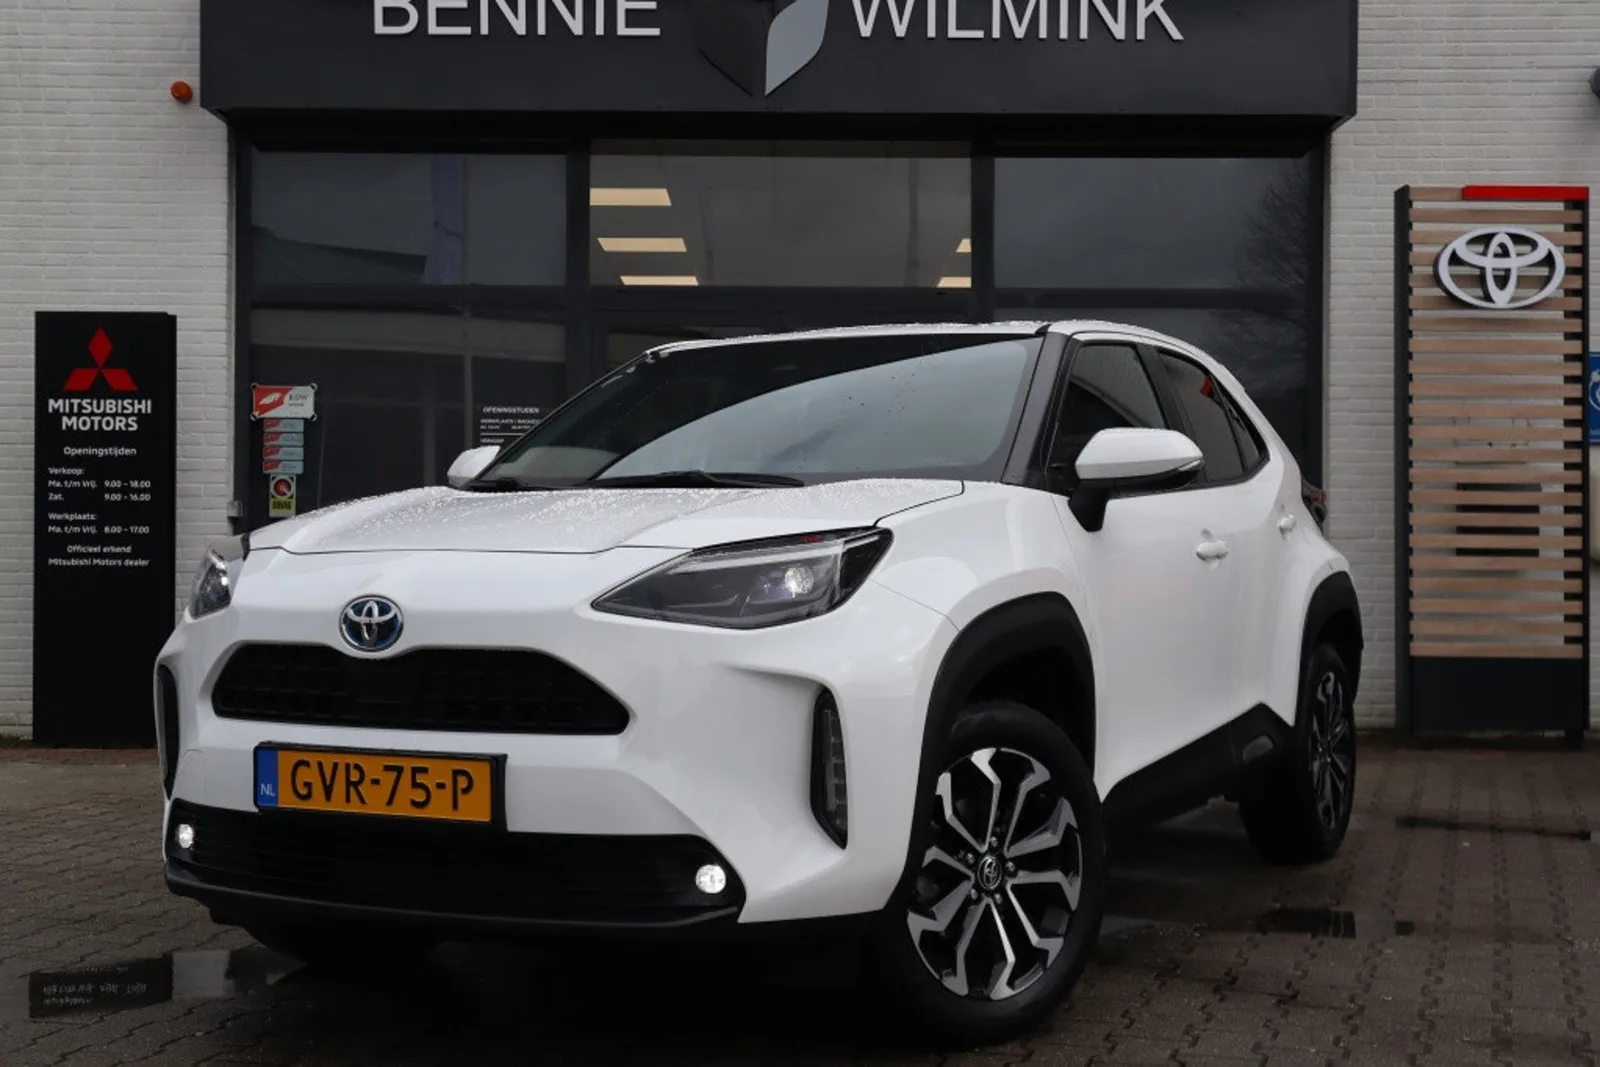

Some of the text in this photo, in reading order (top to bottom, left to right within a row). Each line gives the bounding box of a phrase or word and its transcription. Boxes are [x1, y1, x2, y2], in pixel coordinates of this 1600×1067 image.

[374, 0, 1184, 41] BENNIE WILMINK
[48, 398, 152, 414] MITSUBISHI
[61, 416, 138, 431] MOTORS
[63, 446, 137, 458] Openingstijden
[48, 466, 84, 476] Verkoop:
[104, 480, 122, 488] 9.00
[129, 480, 151, 488] 18.00
[48, 492, 64, 501] Zat.
[104, 493, 122, 501] 9.00
[129, 493, 151, 501] 16.00
[48, 513, 97, 522] Werkplaats:
[48, 558, 150, 566] Mitsubishi Motors dealer
[259, 783, 276, 797] NL
[290, 758, 474, 811] GVR-75-P
